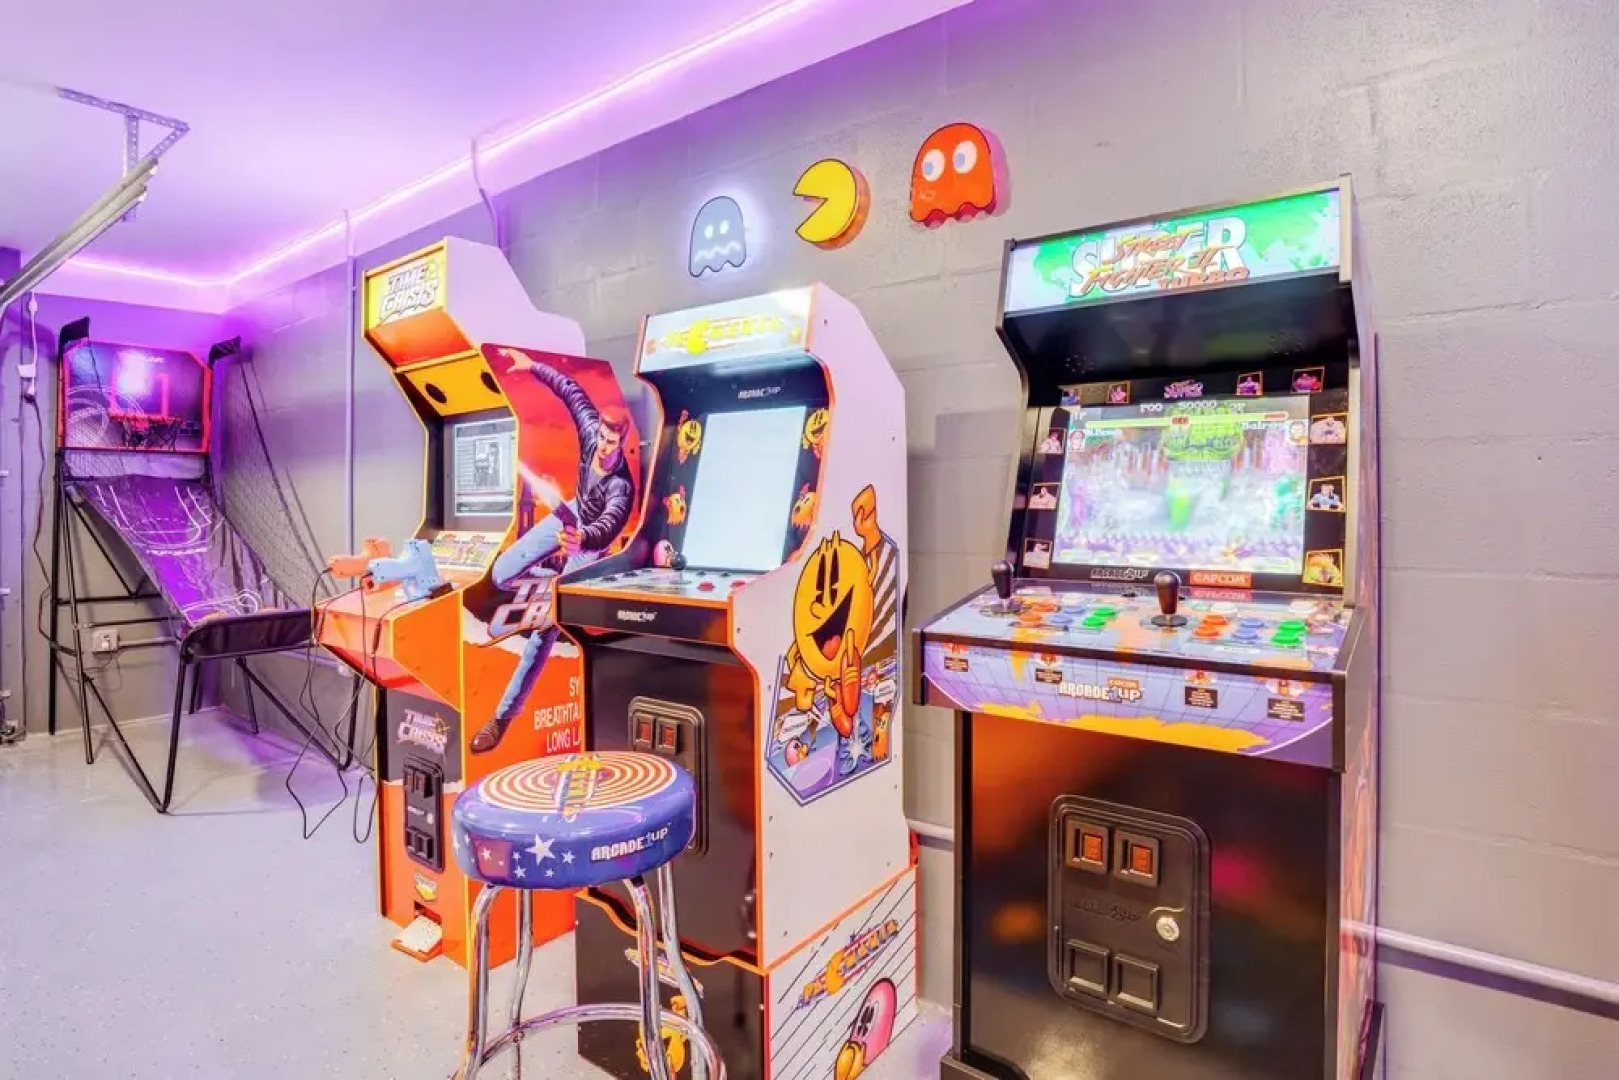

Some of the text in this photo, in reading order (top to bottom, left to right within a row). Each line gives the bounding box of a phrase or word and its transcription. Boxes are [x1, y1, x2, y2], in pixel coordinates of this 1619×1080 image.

[388, 264, 429, 294] TIME
[1158, 267, 1249, 290] TURBO
[379, 279, 440, 322] CRISIS
[1192, 574, 1247, 585] CAPCOM
[546, 727, 571, 753] LONG
